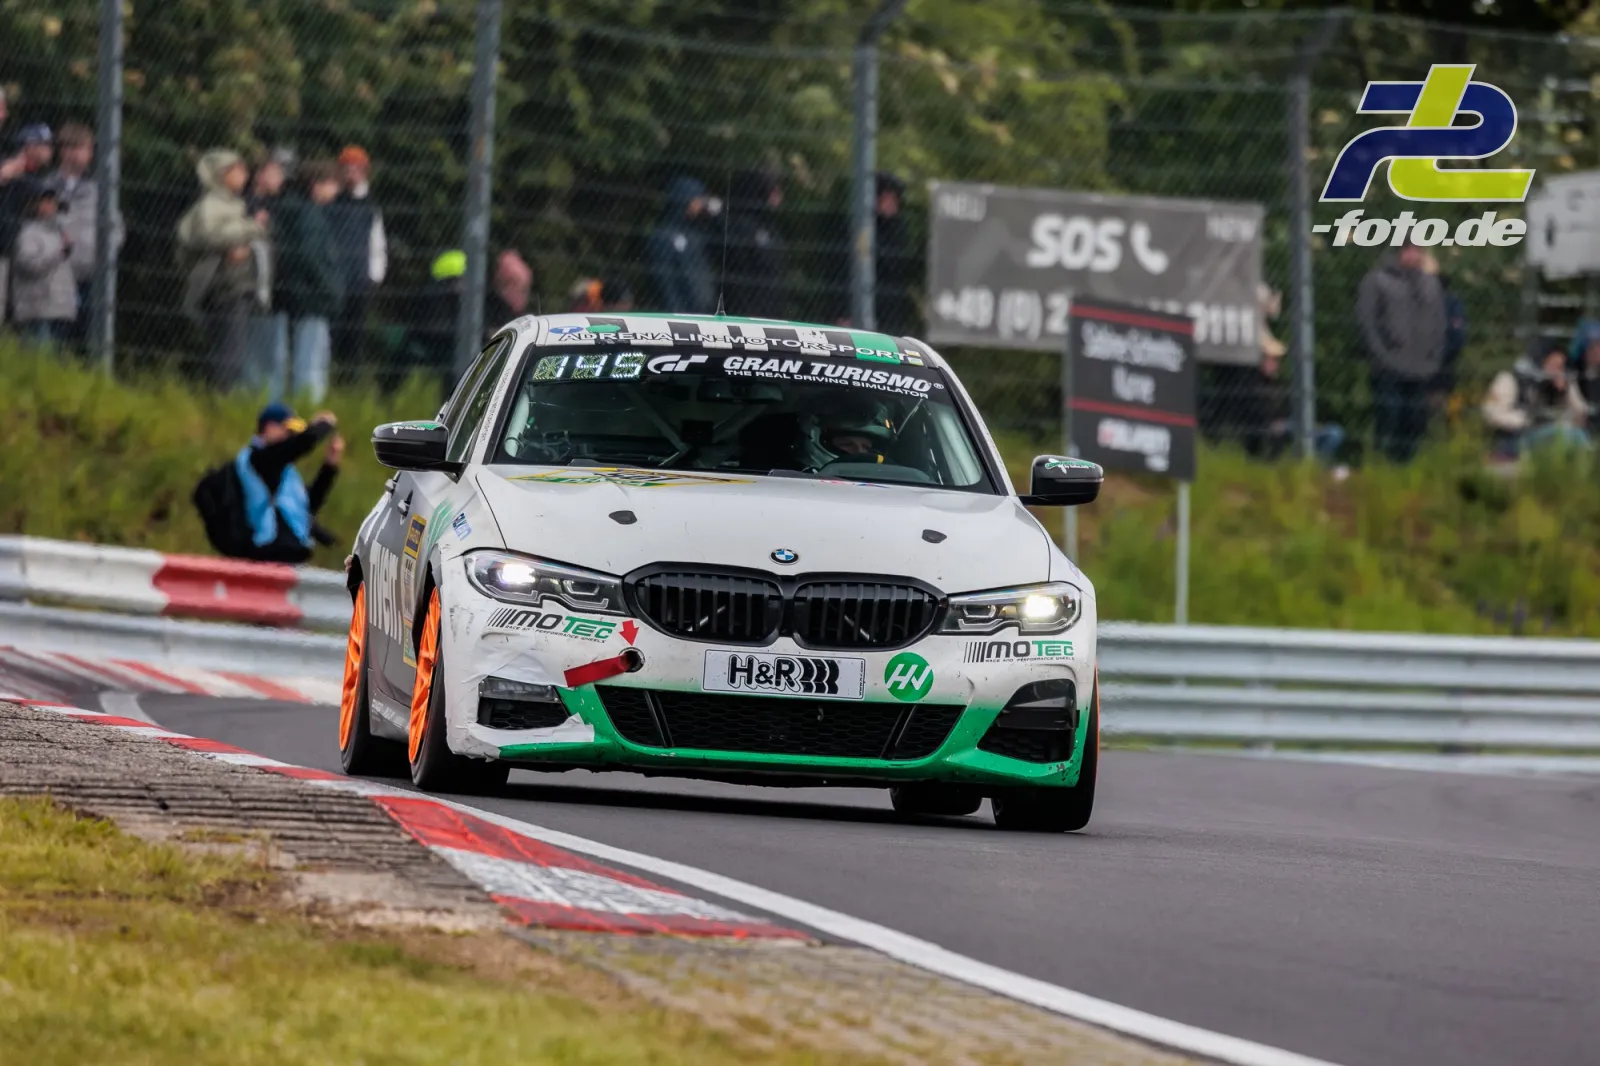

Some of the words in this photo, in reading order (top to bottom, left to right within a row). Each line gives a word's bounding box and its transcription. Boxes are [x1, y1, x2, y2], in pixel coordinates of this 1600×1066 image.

[1026, 213, 1125, 272] SOS
[533, 352, 647, 380] 145
[723, 356, 802, 373] GRAN
[725, 369, 752, 377] THE
[756, 370, 791, 379] REAL
[794, 374, 849, 386] DRIVING
[852, 381, 929, 400] SIMULATOR
[728, 655, 799, 692] H&R
